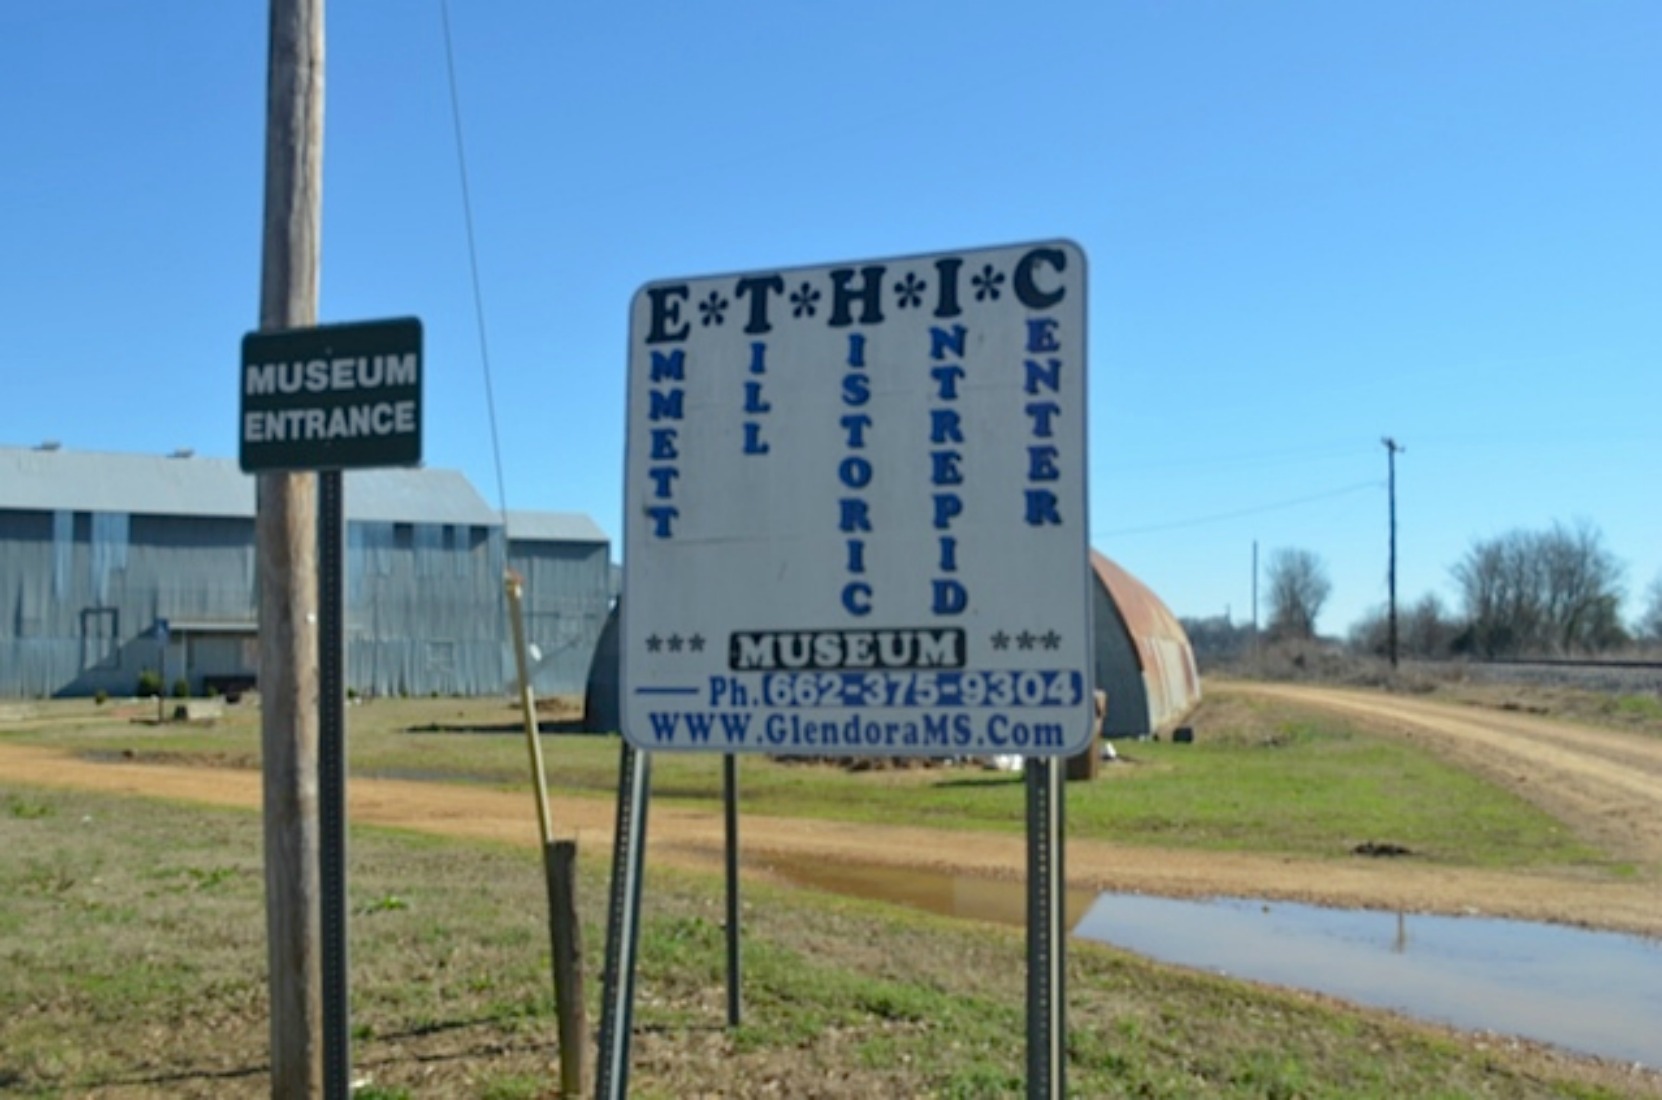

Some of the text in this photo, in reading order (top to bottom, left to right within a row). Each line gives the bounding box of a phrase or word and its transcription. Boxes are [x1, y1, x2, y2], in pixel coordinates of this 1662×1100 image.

[245, 353, 418, 396] MUSEUM
[243, 401, 416, 443] ENTRANCE
[736, 629, 960, 668] MUSEUM
[648, 711, 1065, 748] WWW.GlendoraMS.Com
